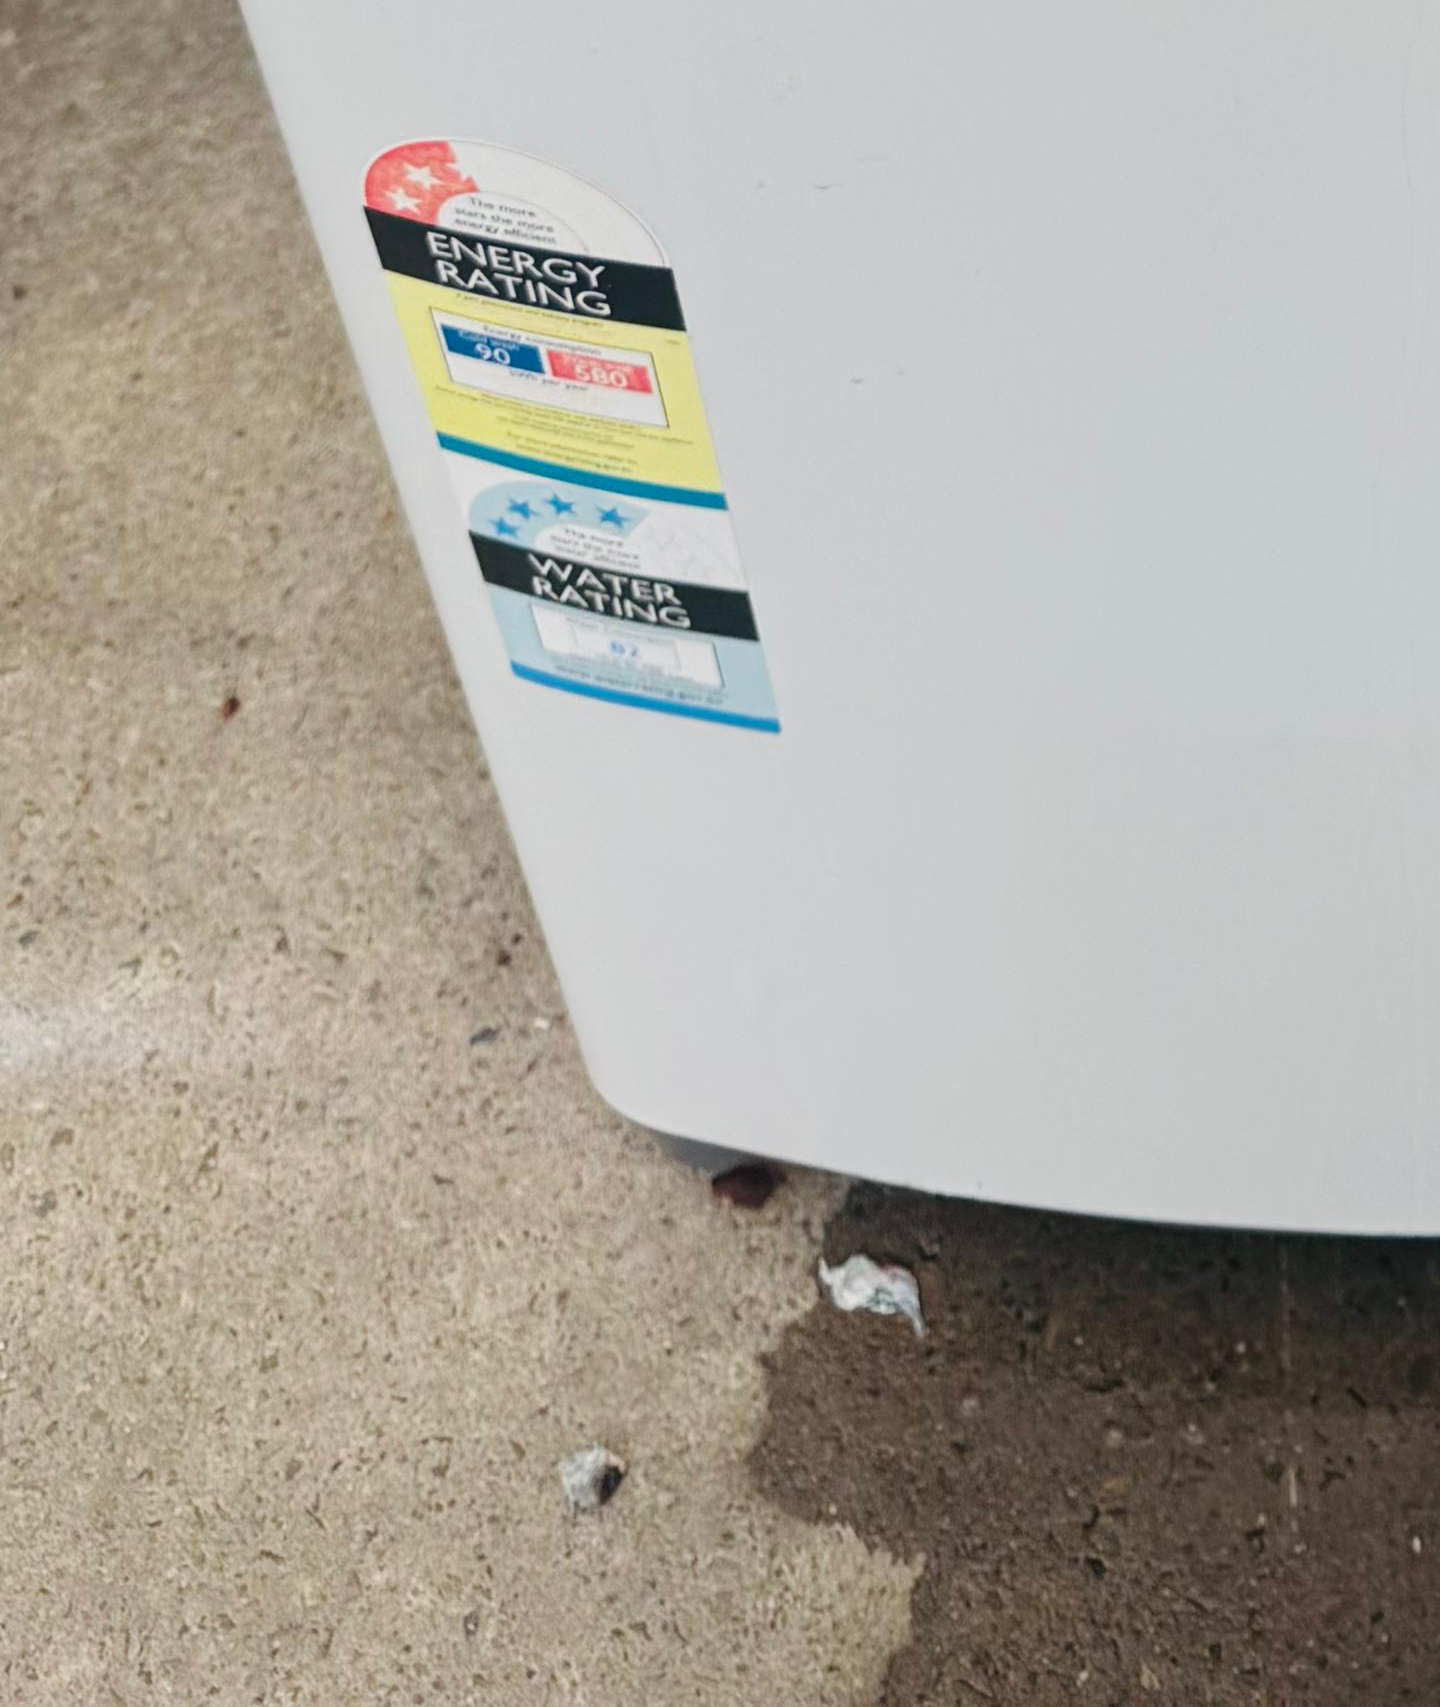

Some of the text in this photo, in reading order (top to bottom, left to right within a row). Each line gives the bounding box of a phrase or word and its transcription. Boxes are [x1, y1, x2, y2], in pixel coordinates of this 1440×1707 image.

[426, 231, 606, 288] ENERGY
[435, 260, 611, 316] RATING
[474, 342, 510, 366] 90
[528, 552, 682, 605] WATER
[532, 576, 691, 629] RATING
